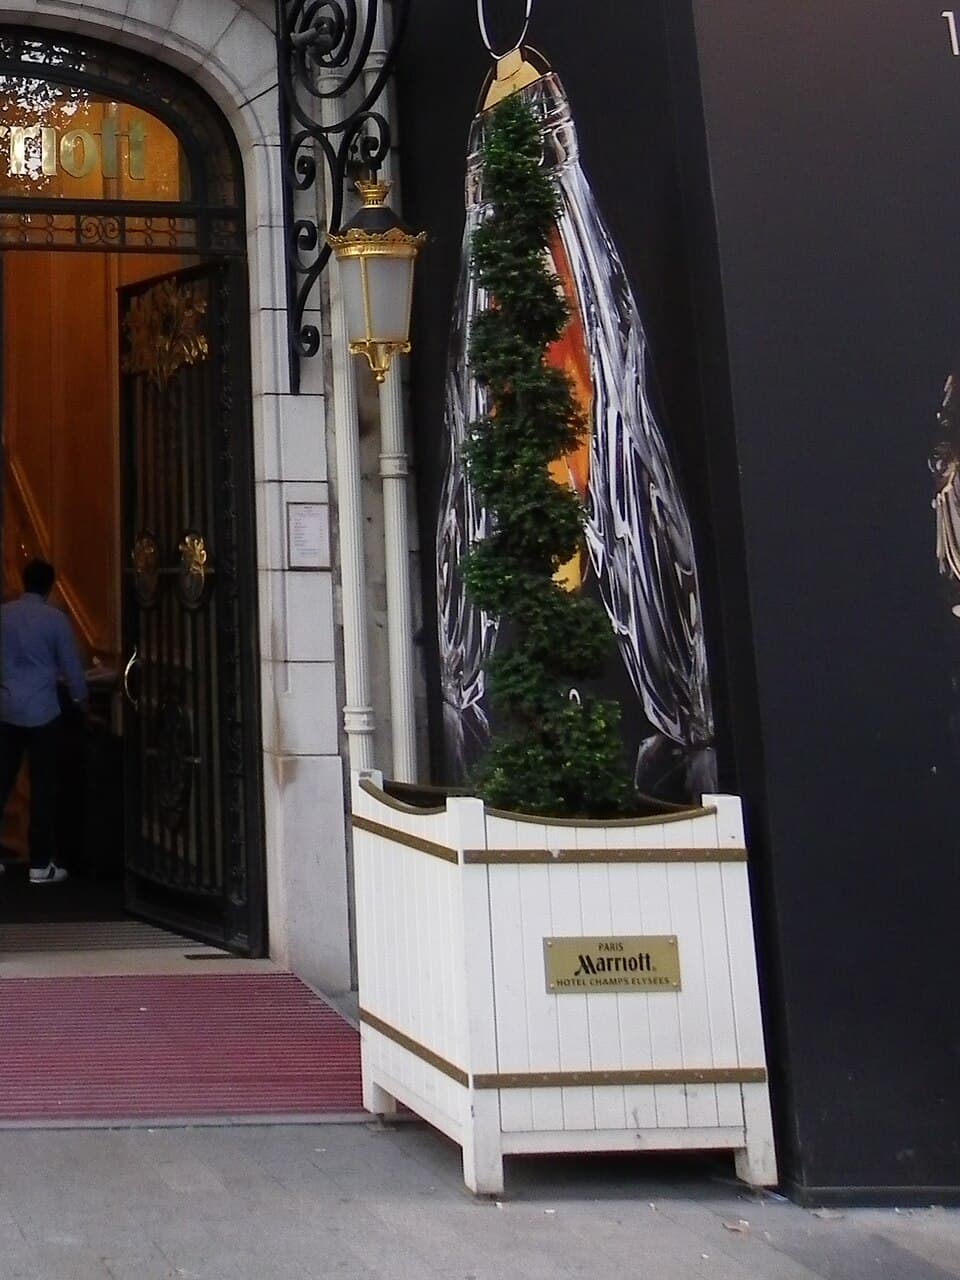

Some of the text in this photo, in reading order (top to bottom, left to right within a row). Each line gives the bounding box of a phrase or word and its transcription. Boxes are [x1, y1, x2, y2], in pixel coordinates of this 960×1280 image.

[598, 942, 624, 952] PARIS
[574, 953, 651, 976] Marriott
[556, 978, 586, 987] HOTEL
[589, 977, 629, 986] CHAMPS
